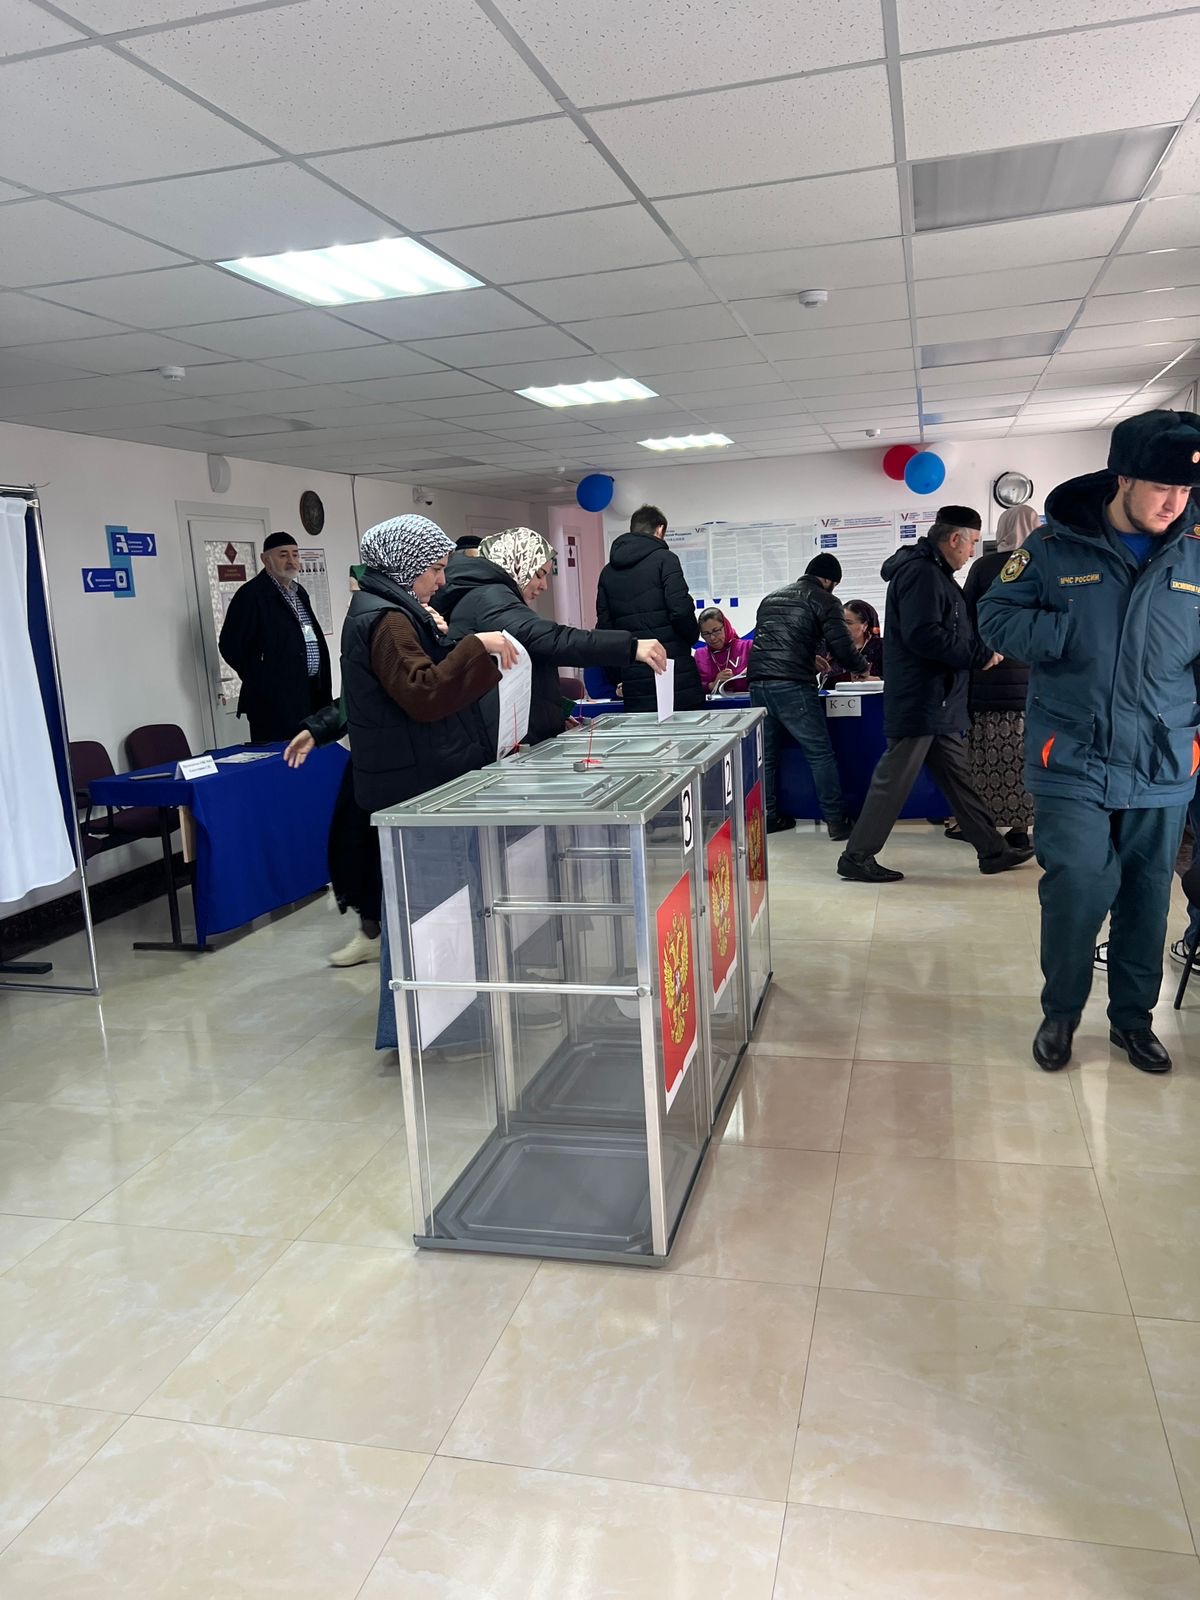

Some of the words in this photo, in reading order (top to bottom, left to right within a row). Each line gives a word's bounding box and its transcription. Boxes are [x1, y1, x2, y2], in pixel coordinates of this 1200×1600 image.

[1060, 576, 1074, 585] МЧС
[1074, 573, 1100, 584] РОССИИ
[725, 760, 732, 797] 2
[683, 789, 692, 848] 3
